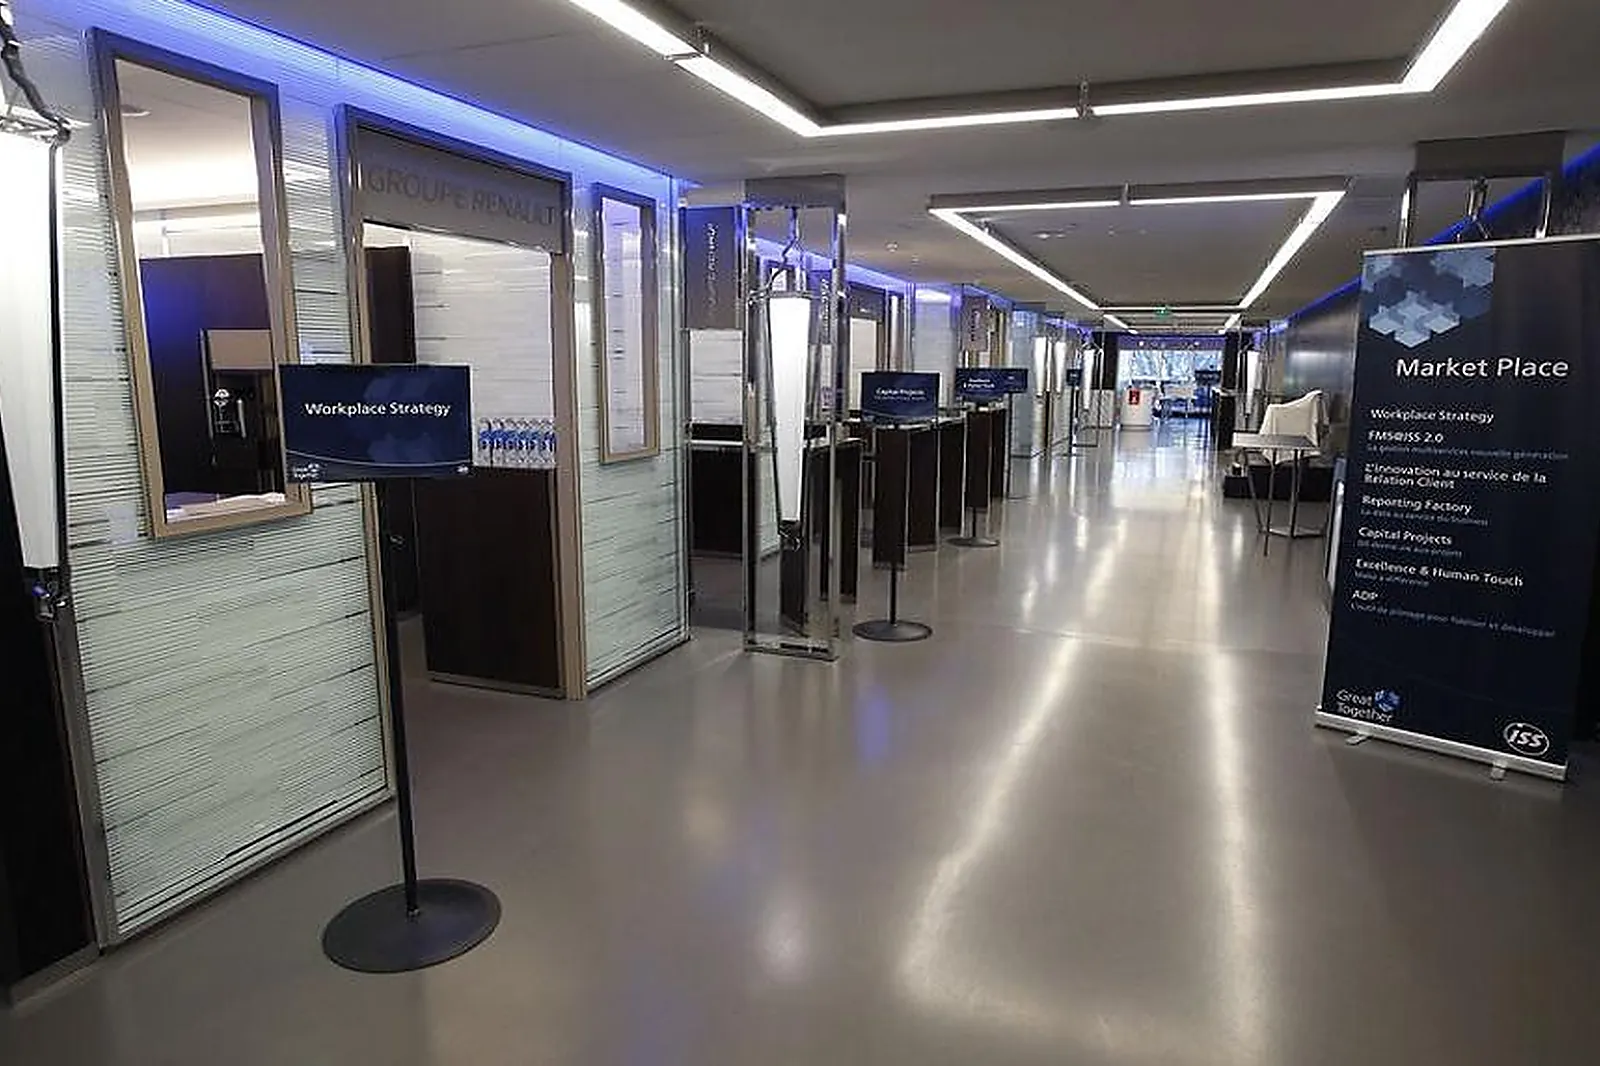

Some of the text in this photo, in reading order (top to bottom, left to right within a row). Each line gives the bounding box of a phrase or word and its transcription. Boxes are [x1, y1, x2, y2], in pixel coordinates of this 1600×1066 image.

[1396, 357, 1569, 377] Market Place
[305, 402, 451, 417] Workplace Strategy
[1371, 409, 1494, 424] Workplace Strategy
[1424, 432, 1444, 443] 2.0
[1417, 477, 1455, 488] Client
[1463, 469, 1509, 481] service
[1512, 470, 1530, 482] de
[1533, 472, 1546, 483] la
[1361, 495, 1472, 515] Reporting Factory
[1358, 526, 1452, 545] Capital Projects
[1355, 558, 1417, 575] Excellence
[1432, 567, 1480, 582] Human
[1484, 573, 1524, 587] Touch
[1336, 688, 1373, 706] Great
[1338, 700, 1392, 723] Together
